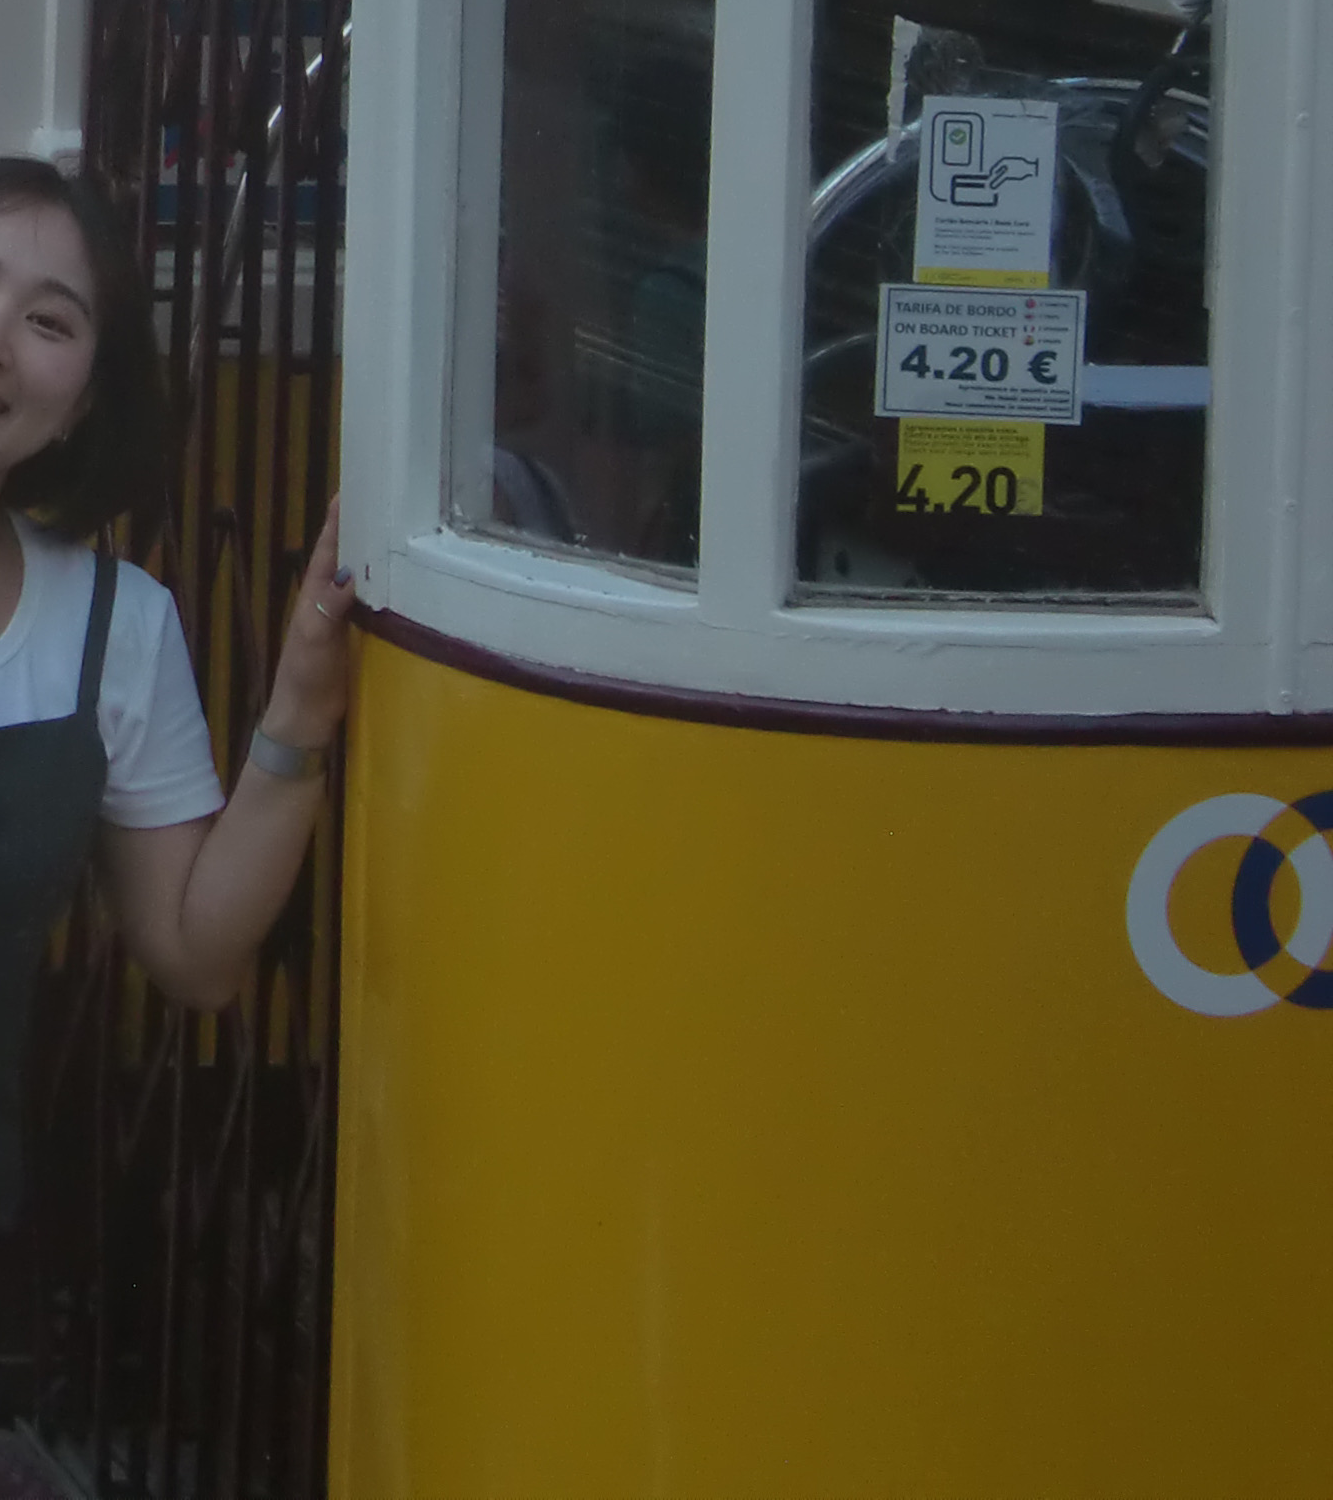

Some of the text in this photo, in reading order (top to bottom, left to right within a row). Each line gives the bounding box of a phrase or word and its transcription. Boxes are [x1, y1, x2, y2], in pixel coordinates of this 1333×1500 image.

[896, 301, 1017, 318] TARIFA DE BORDO
[895, 322, 1017, 338] ON BOARD TICKET
[900, 343, 1058, 385] 4.20 €
[896, 463, 1018, 514] 4.20
